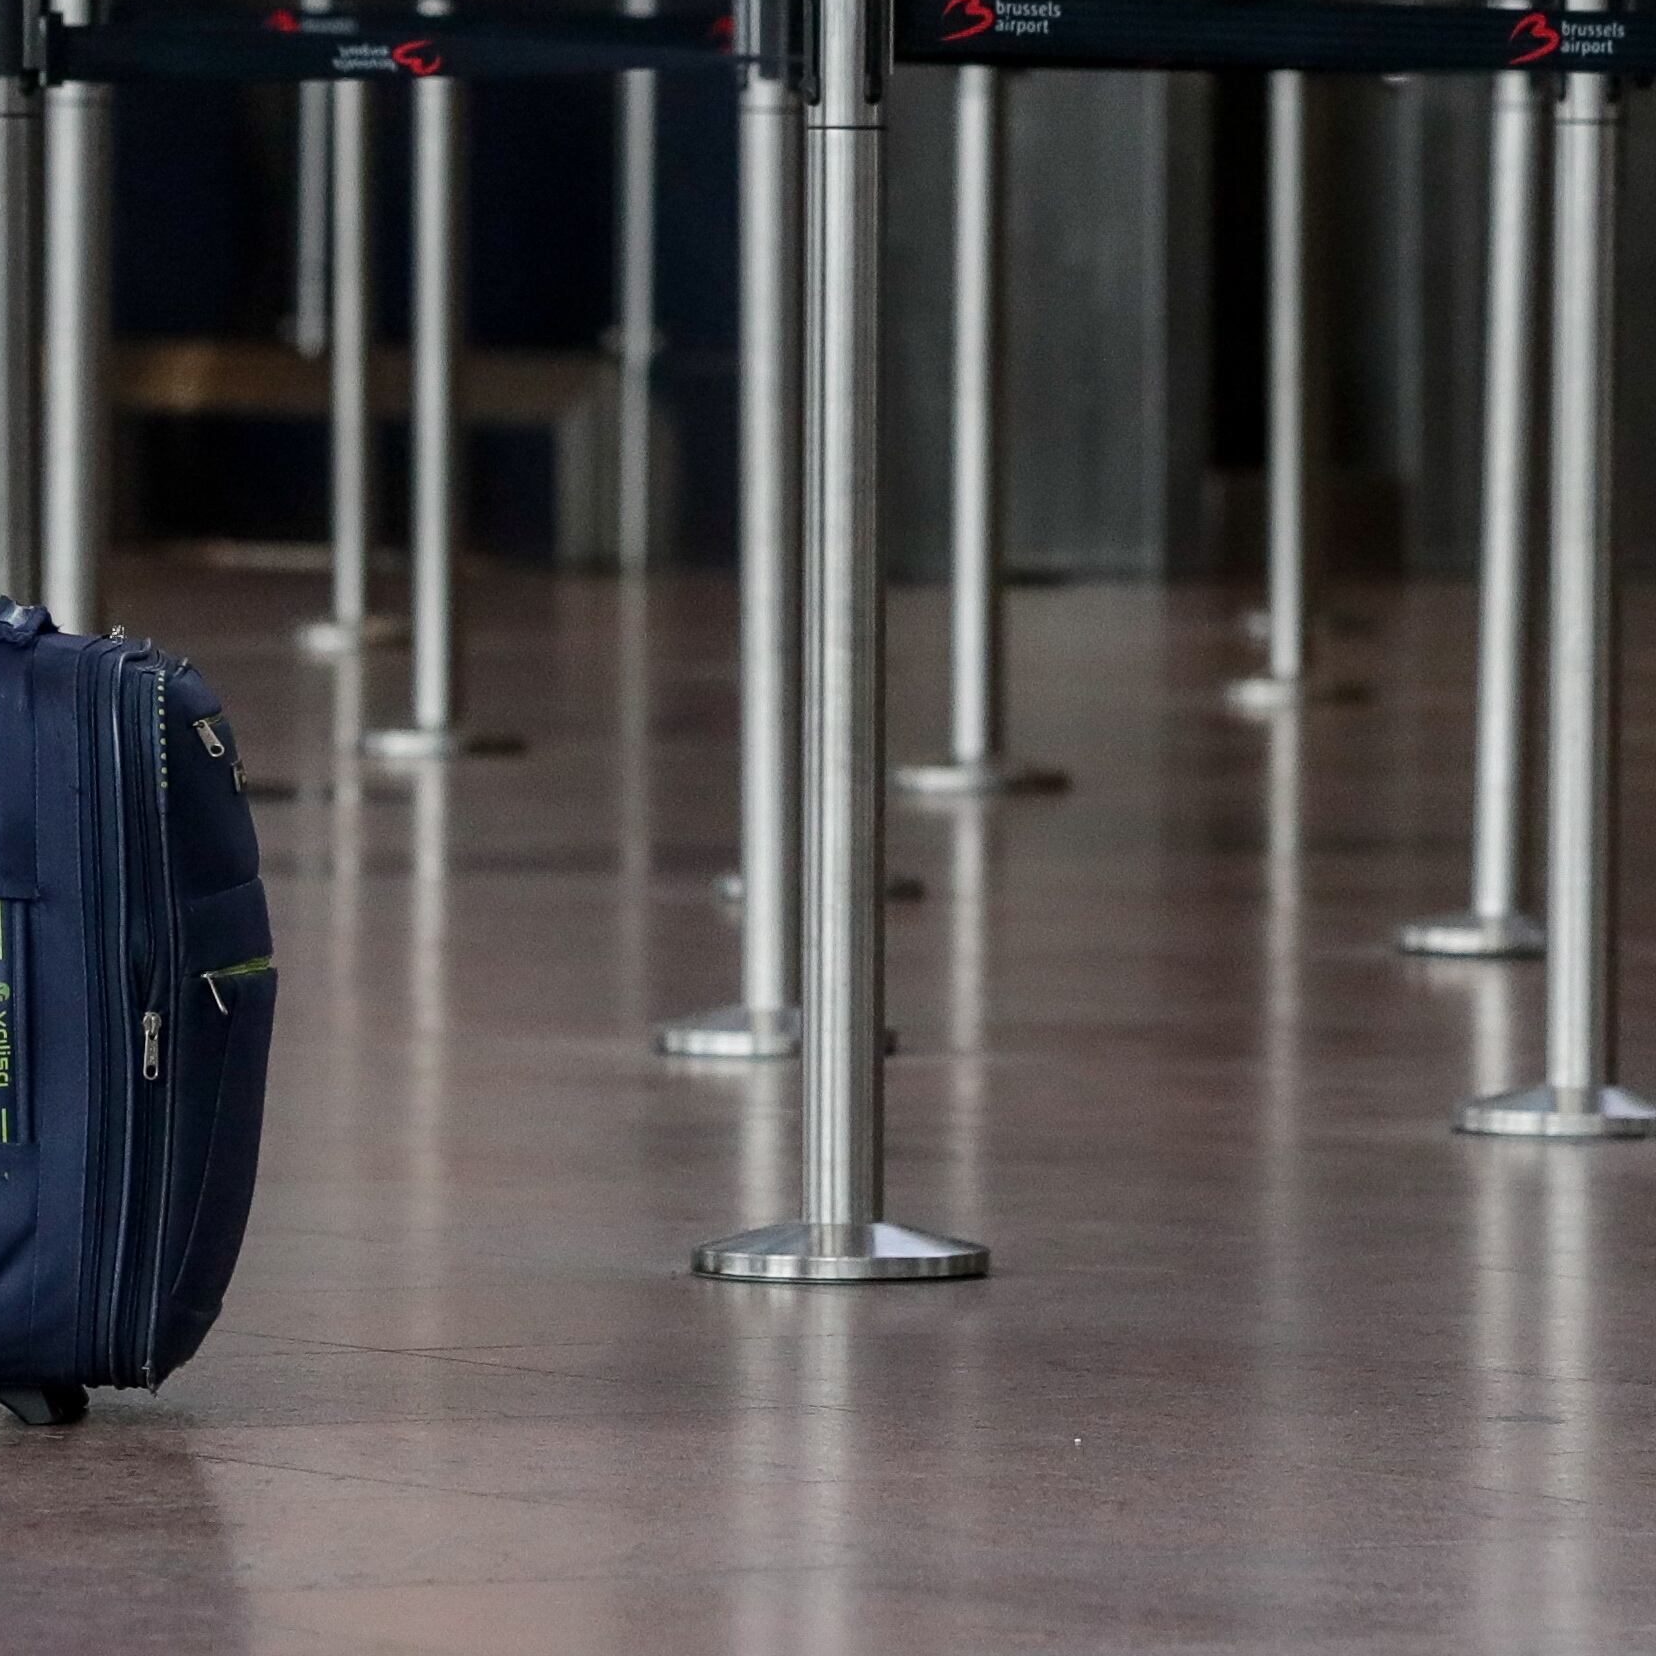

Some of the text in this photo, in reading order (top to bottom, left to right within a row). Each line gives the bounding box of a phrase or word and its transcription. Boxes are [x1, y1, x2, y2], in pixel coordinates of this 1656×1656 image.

[995, 0, 1062, 18] brussels
[995, 19, 1049, 36] airport
[1561, 21, 1625, 38] brussels
[1560, 38, 1614, 56] airport
